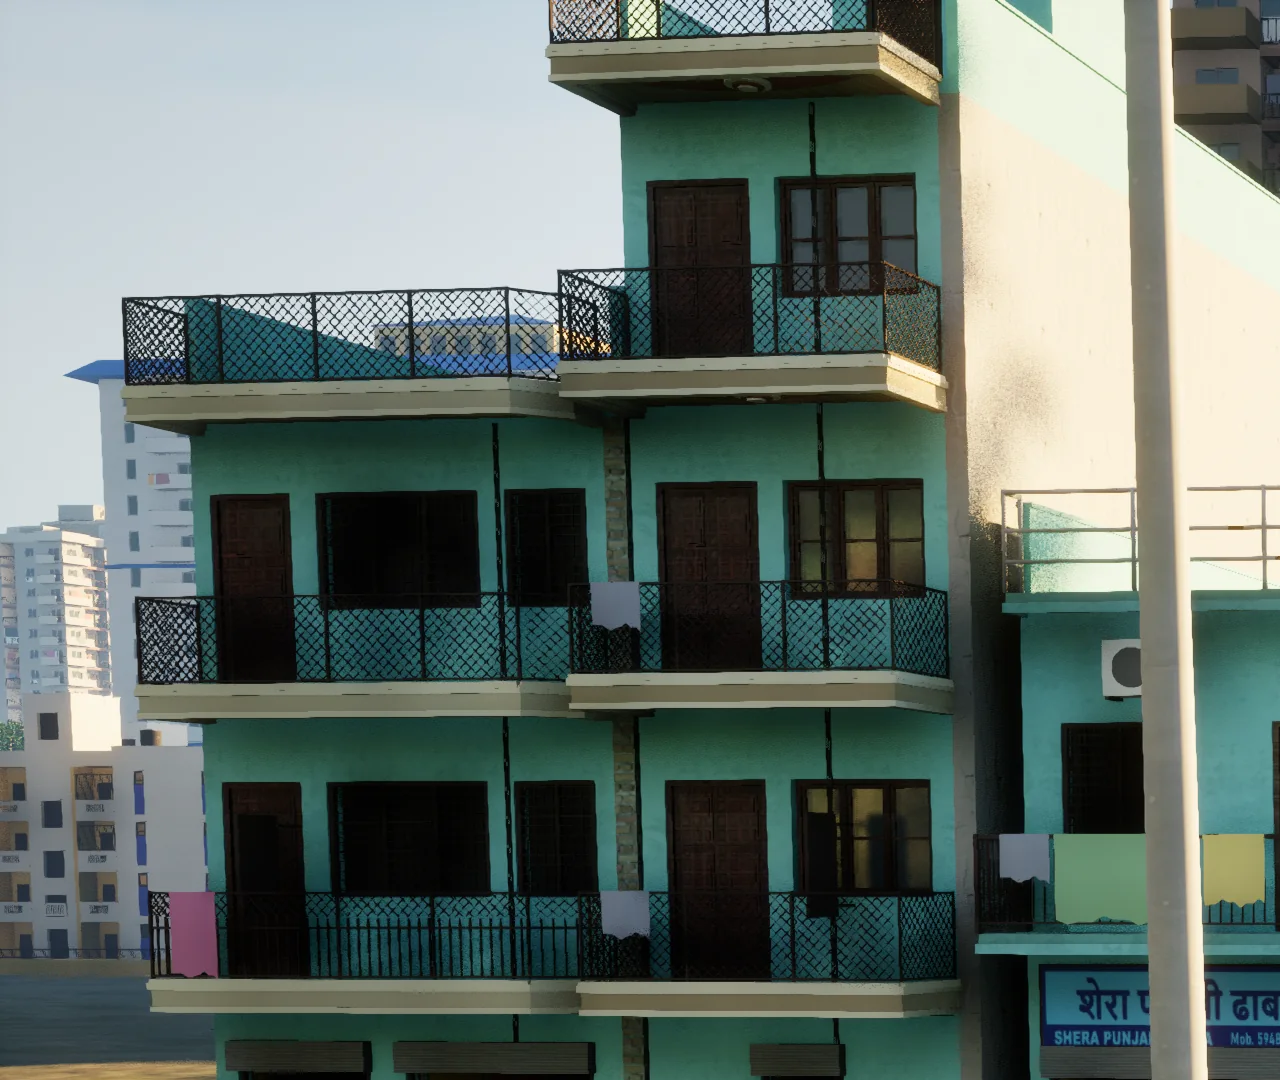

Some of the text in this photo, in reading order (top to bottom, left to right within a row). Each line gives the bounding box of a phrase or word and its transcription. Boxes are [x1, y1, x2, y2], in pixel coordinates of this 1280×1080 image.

[1076, 977, 1130, 1021] शेरा
[1054, 1030, 1100, 1046] SHERA
[1103, 1030, 1151, 1046] PUNJA
[1230, 1032, 1254, 1046] Mob.
